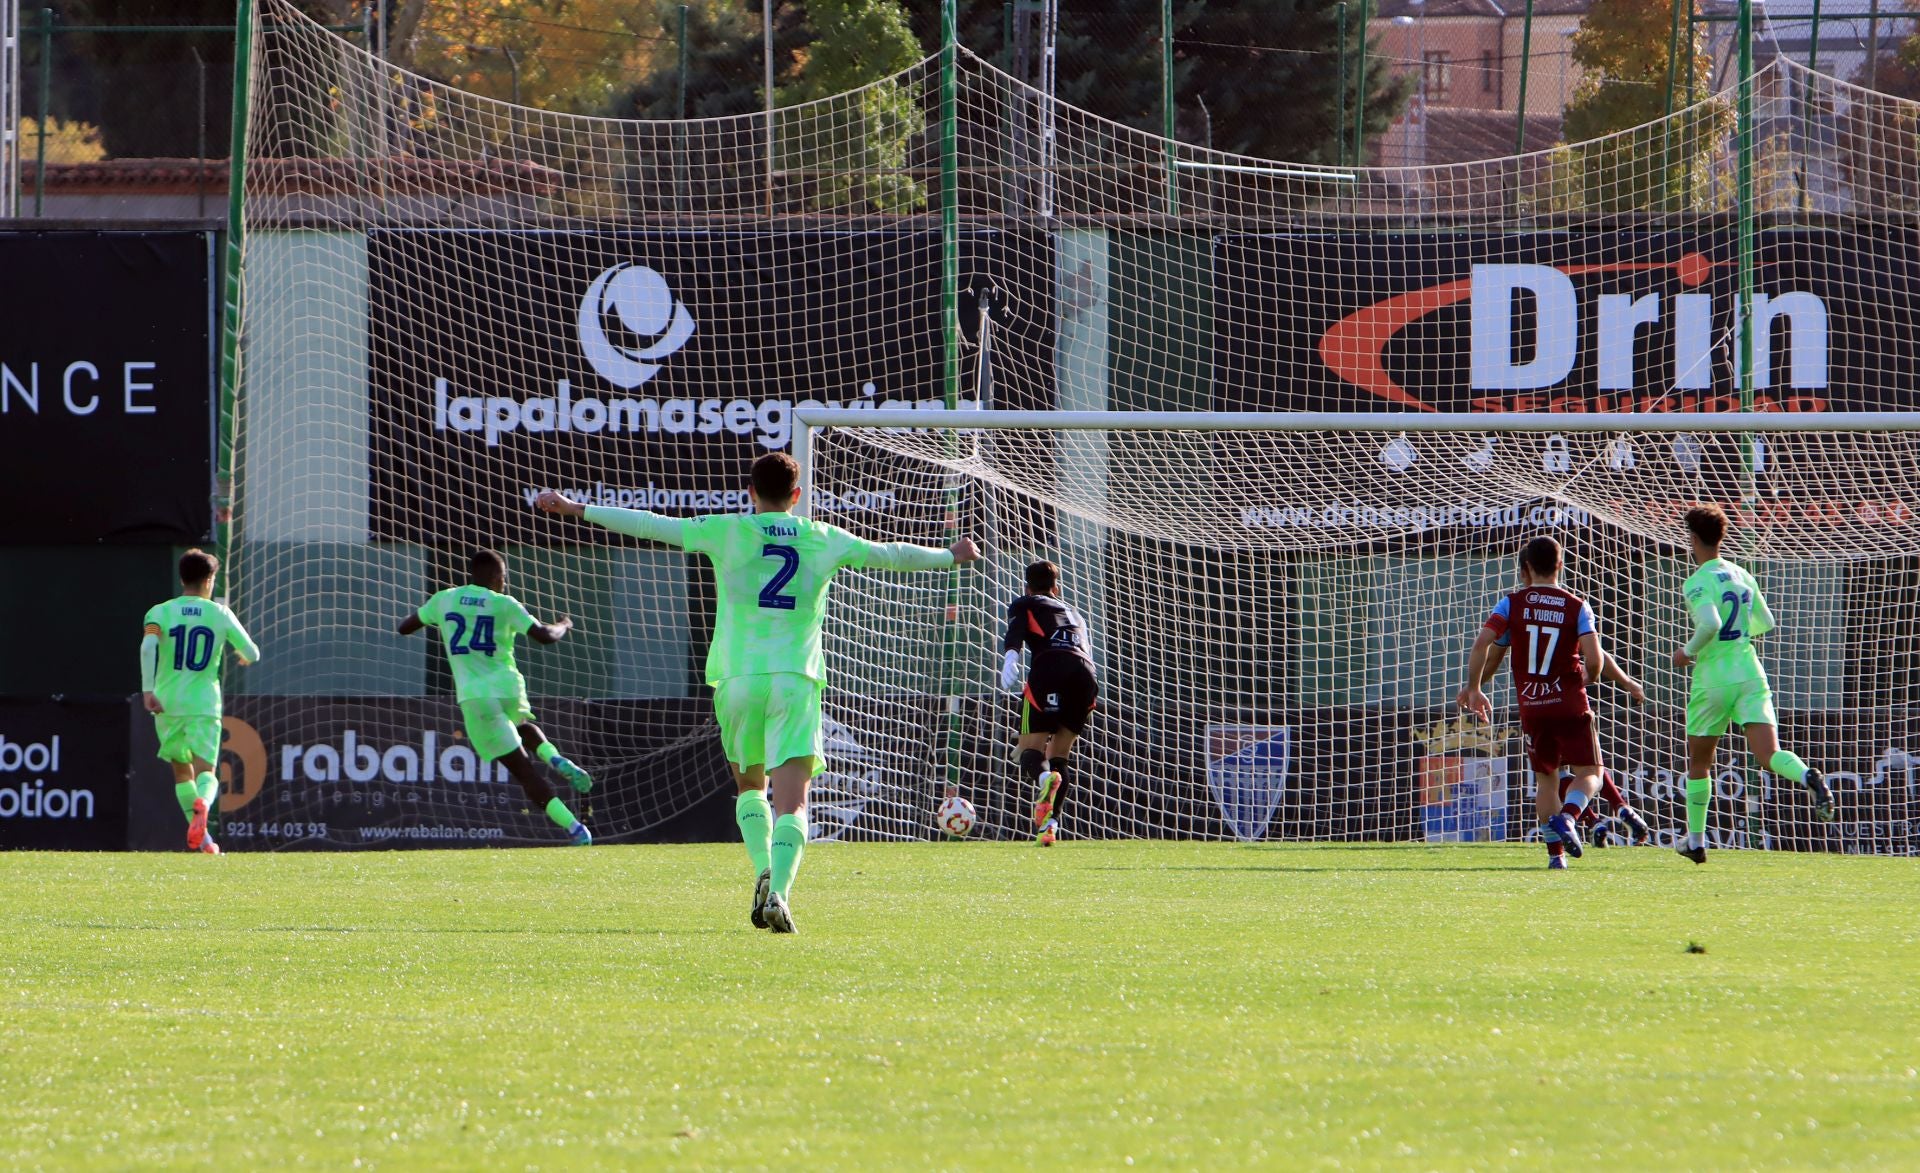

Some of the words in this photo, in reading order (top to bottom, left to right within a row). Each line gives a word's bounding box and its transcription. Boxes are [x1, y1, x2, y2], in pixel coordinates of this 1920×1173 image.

[1470, 252, 1829, 391] Drin
[1, 360, 157, 416] NCE
[523, 480, 897, 516] ww.lapalomasegna.com
[762, 524, 798, 537] TRILLI
[758, 544, 800, 610] 2
[181, 606, 202, 617] UNAI
[1533, 609, 1564, 624] YUBERO
[168, 624, 215, 672] 10
[445, 611, 497, 657] 24
[1526, 624, 1560, 676] 17
[226, 822, 255, 836] 921
[259, 822, 280, 836] 44
[283, 822, 304, 837] 03
[307, 822, 327, 837] 93
[359, 824, 504, 840] www.rabalan.com
[1829, 820, 1920, 838] NUESTR
